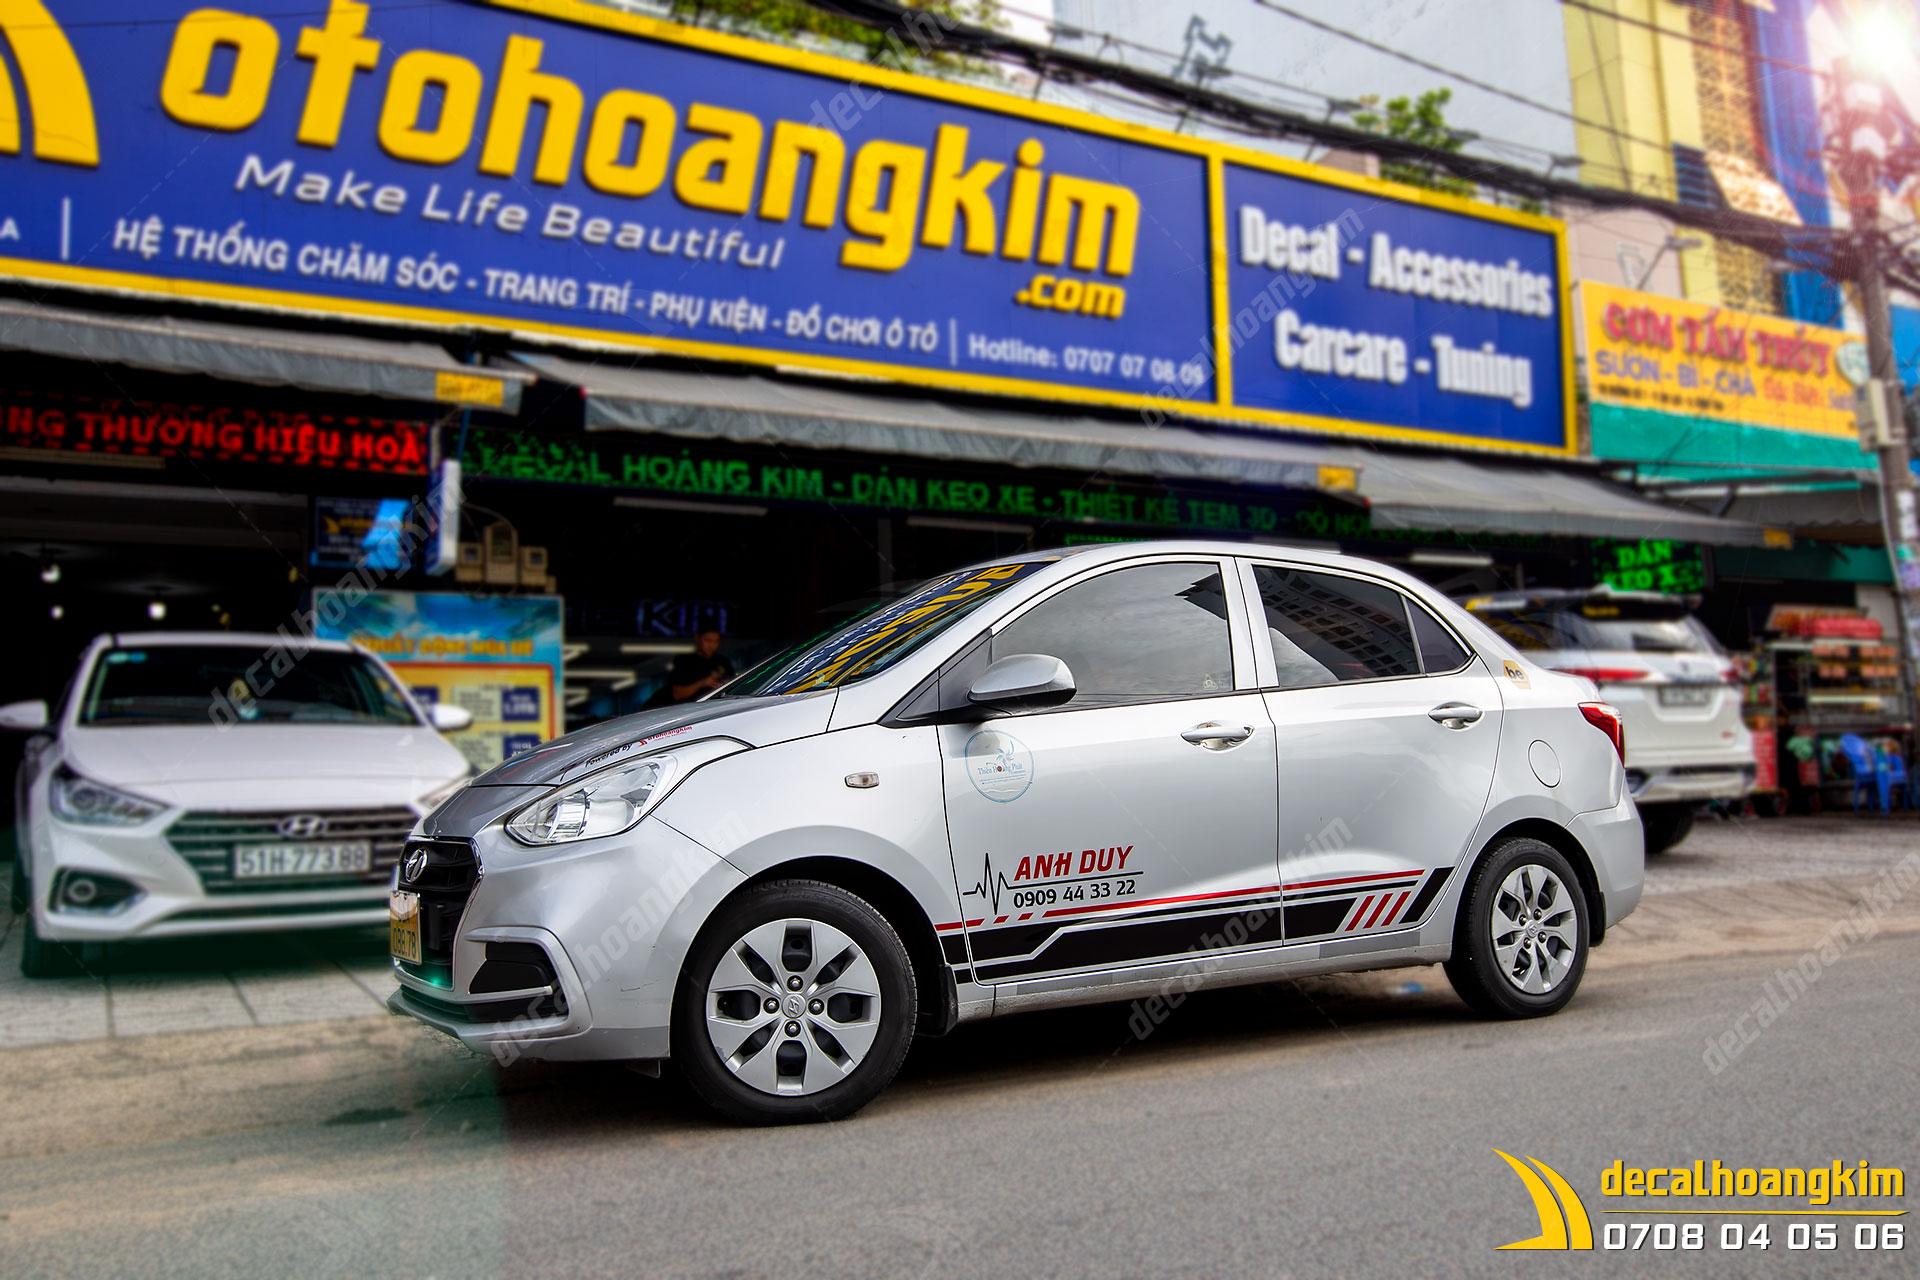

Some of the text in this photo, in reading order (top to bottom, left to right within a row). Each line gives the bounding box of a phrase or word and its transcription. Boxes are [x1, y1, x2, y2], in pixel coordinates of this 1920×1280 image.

[160, 0, 1140, 275] otohoangkim
[235, 155, 785, 269] Make Life Beautiful
[112, 215, 163, 259] HỆ
[174, 220, 289, 270] THỐNG
[297, 243, 390, 283] CHĂM
[395, 252, 460, 292] SÓC
[484, 268, 578, 307] TRANG
[586, 280, 631, 314] TRÍ
[651, 291, 702, 329] PHỤ
[708, 297, 767, 333] KIỆN
[908, 322, 938, 352] TÔ
[1240, 205, 1341, 281] Decal
[1368, 232, 1553, 317] Accessories
[1016, 273, 1126, 319] .com
[968, 334, 1057, 368] Hotline:
[1064, 346, 1115, 375] 0707
[1120, 352, 1145, 378] 07
[1274, 308, 1408, 386] Carcare
[1432, 332, 1532, 408] Tuning
[762, 466, 824, 497] KIM
[1505, 666, 1524, 679] be
[1014, 845, 1134, 881] ANH DUY
[1013, 879, 1136, 908] 0909 44 33 22
